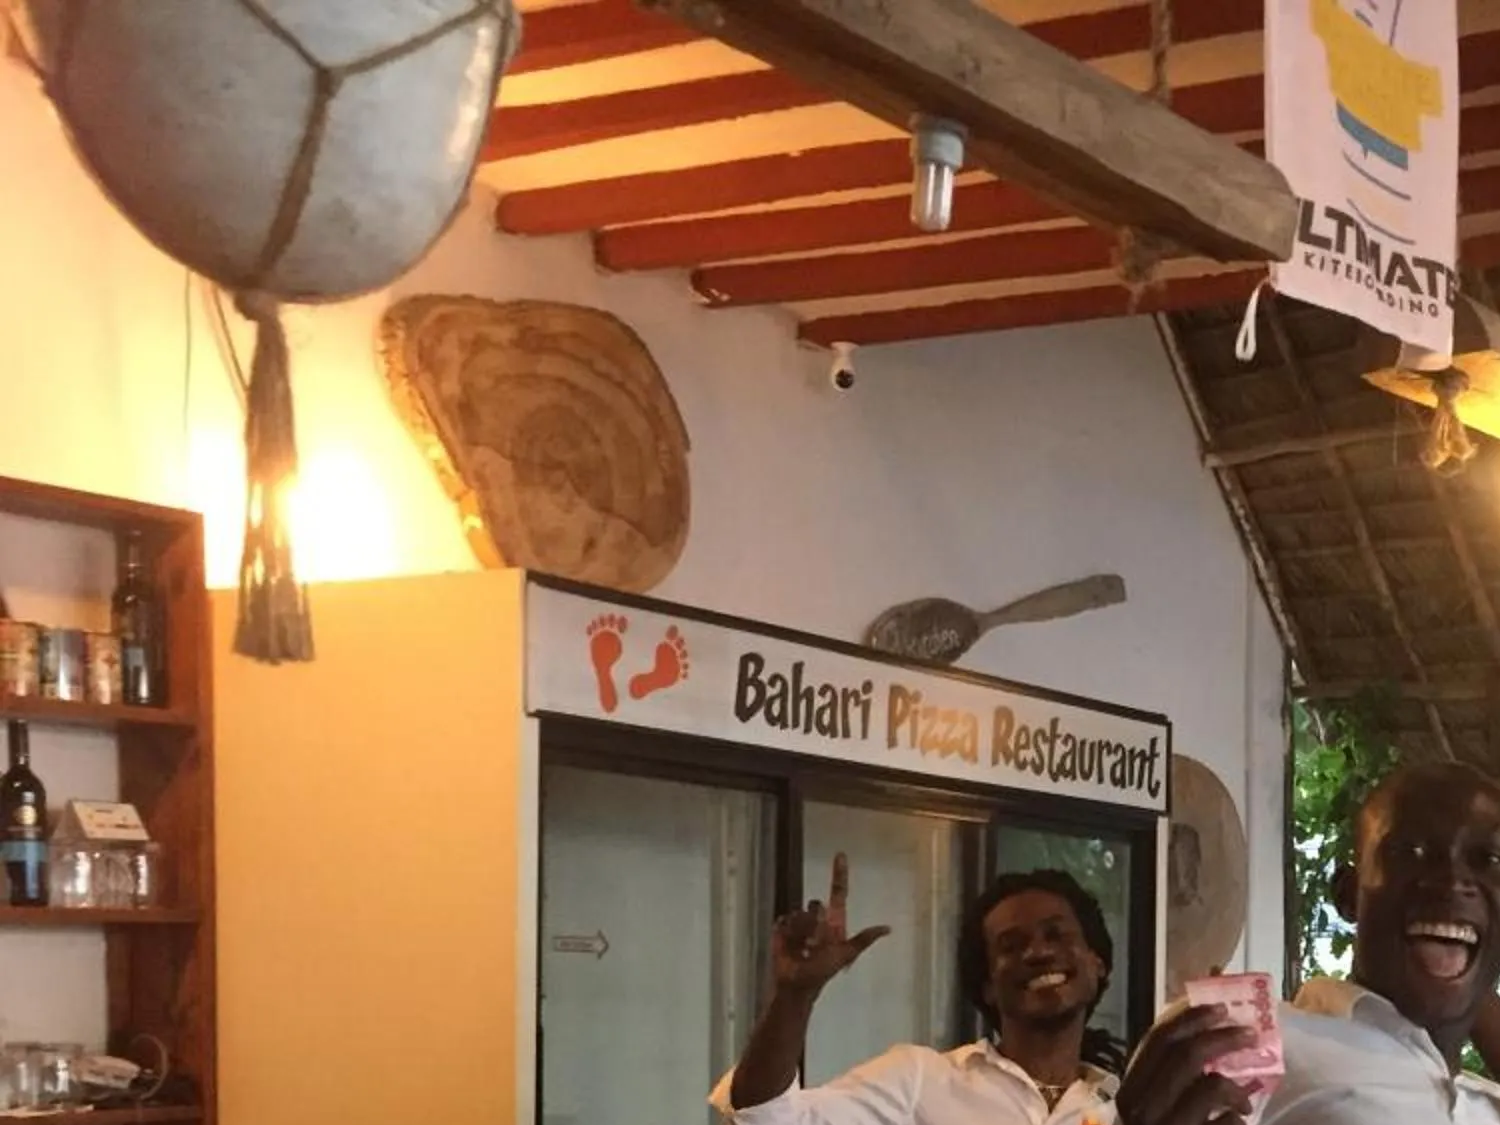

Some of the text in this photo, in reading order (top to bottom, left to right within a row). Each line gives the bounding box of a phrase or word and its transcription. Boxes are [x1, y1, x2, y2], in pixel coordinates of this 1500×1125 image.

[734, 651, 1162, 798] Bahari Pizza Restaurant
